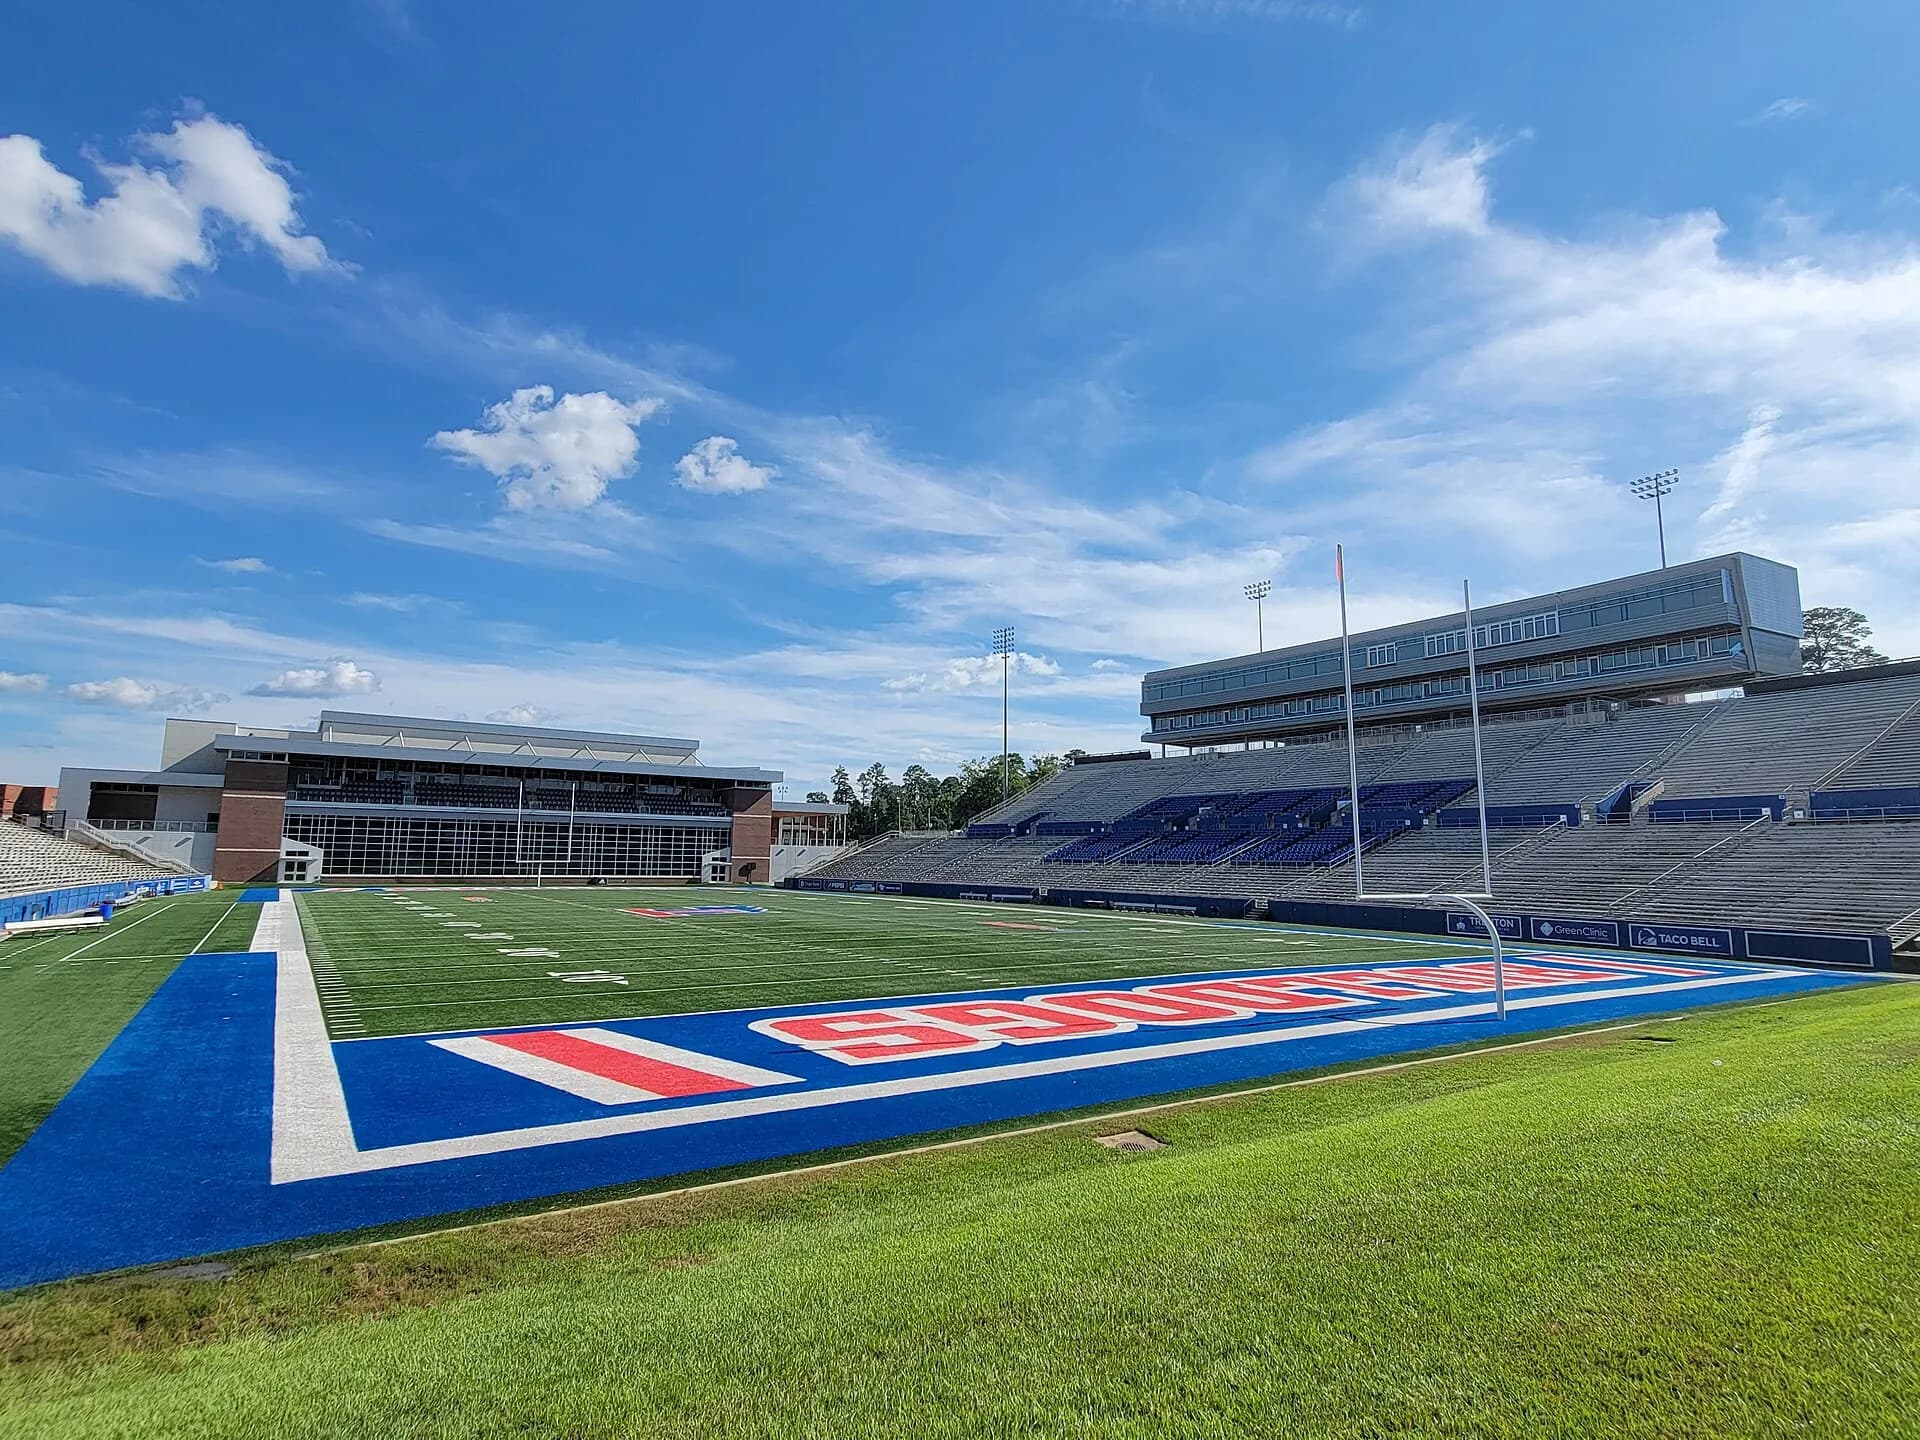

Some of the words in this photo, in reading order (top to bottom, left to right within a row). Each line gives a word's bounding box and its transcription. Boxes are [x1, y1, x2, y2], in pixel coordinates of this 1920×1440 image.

[1469, 917, 1514, 928] TRETON
[1658, 934, 1689, 945] TACO
[1690, 936, 1721, 948] BELL
[748, 962, 1648, 1066] BULLDOGS
